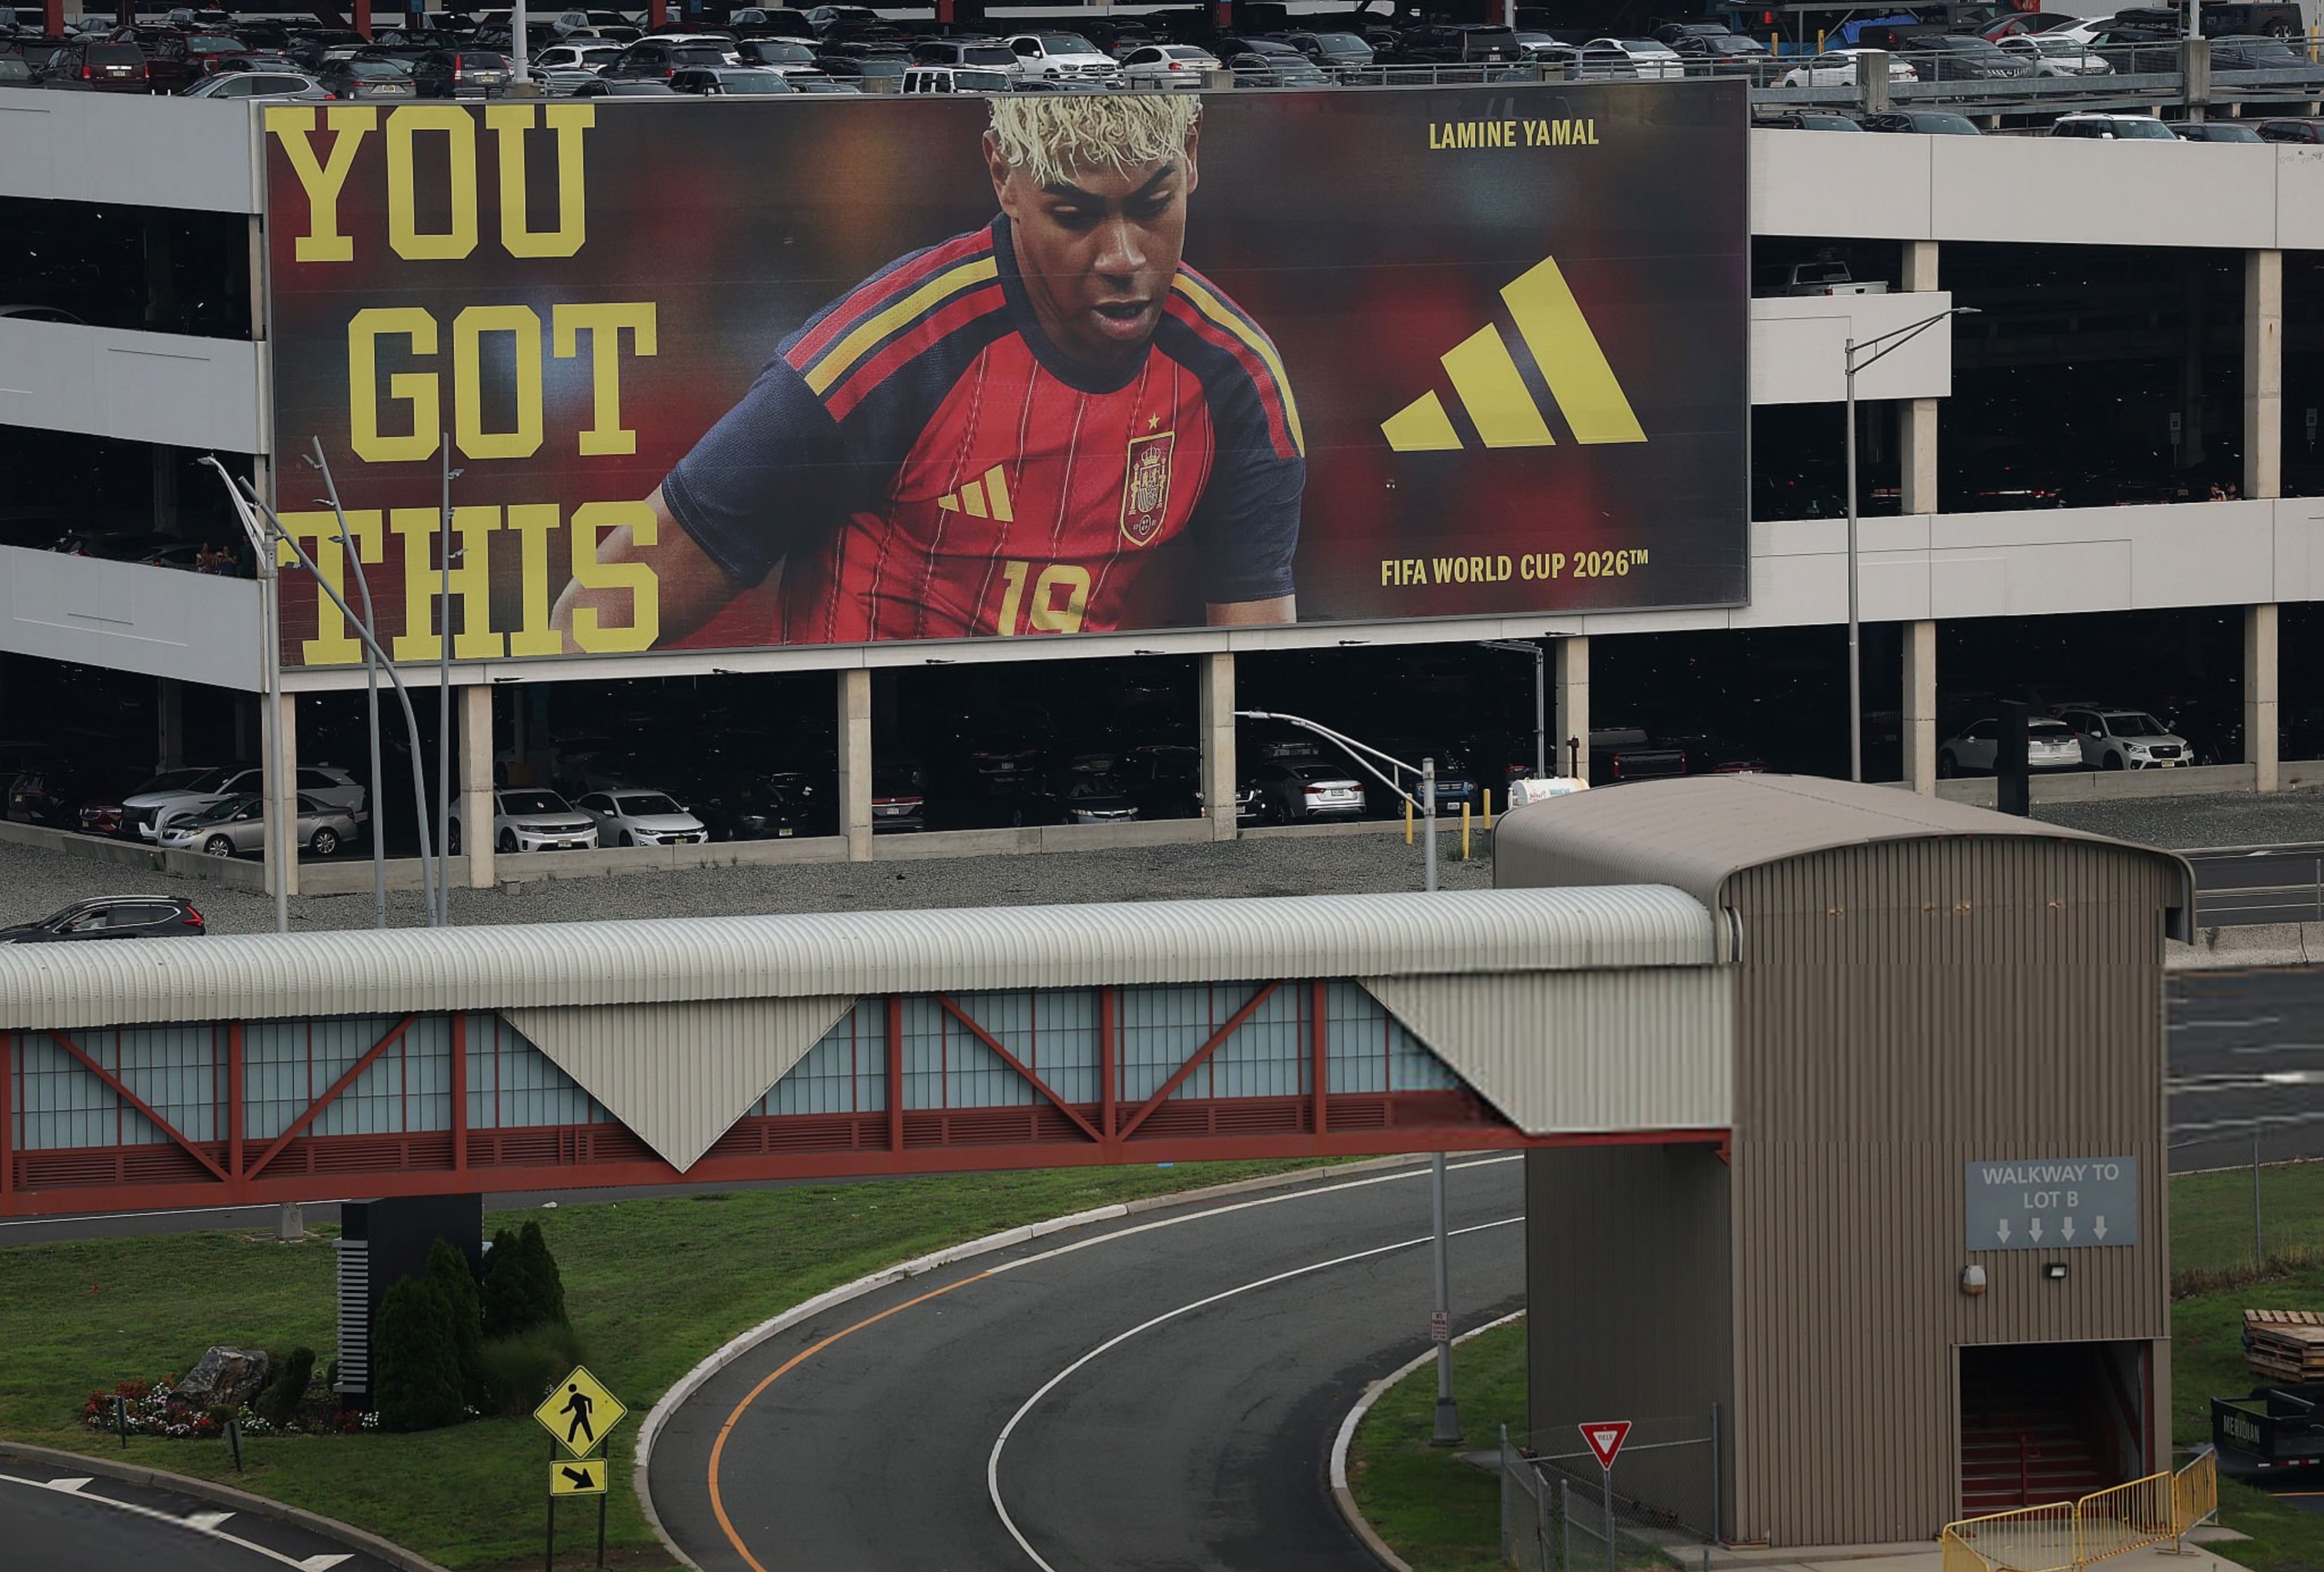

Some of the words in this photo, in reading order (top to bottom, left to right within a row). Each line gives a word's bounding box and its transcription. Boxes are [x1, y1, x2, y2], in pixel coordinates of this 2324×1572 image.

[1429, 121, 1517, 149] LAMINE
[1523, 119, 1599, 146] YAMAL
[265, 103, 595, 262] YOU
[348, 302, 658, 463] GOT
[276, 501, 659, 665] THIS
[1380, 559, 1428, 586] FIFA
[1432, 556, 1513, 583] WORLD
[1520, 552, 1565, 580] CUP
[1982, 1165, 2087, 1184] WALKWAY
[2092, 1163, 2120, 1180] TO
[2024, 1191, 2061, 1209] LOT
[2067, 1191, 2079, 1208] B
[2224, 1414, 2260, 1445] MERIDIAN
